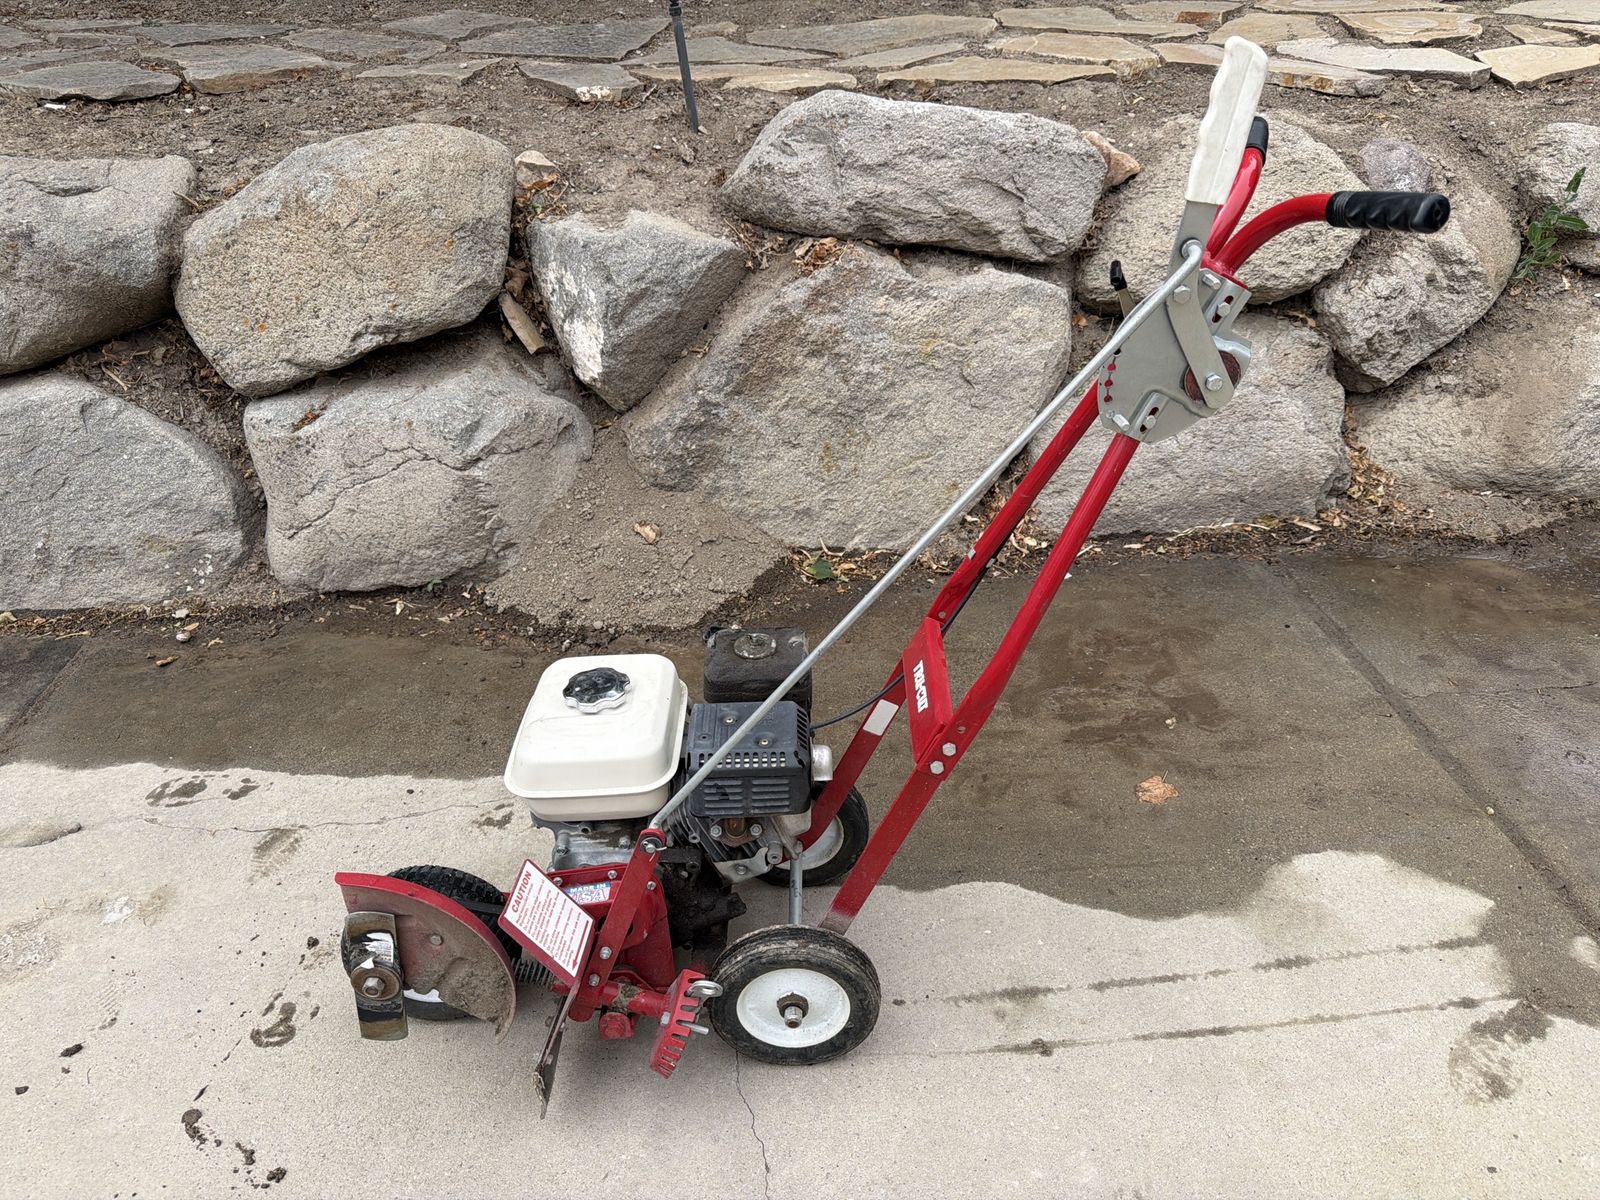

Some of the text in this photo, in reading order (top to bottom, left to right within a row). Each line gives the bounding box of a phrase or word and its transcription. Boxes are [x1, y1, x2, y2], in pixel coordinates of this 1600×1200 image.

[511, 870, 532, 913] CAUTION
[570, 882, 607, 893] MADE IN
